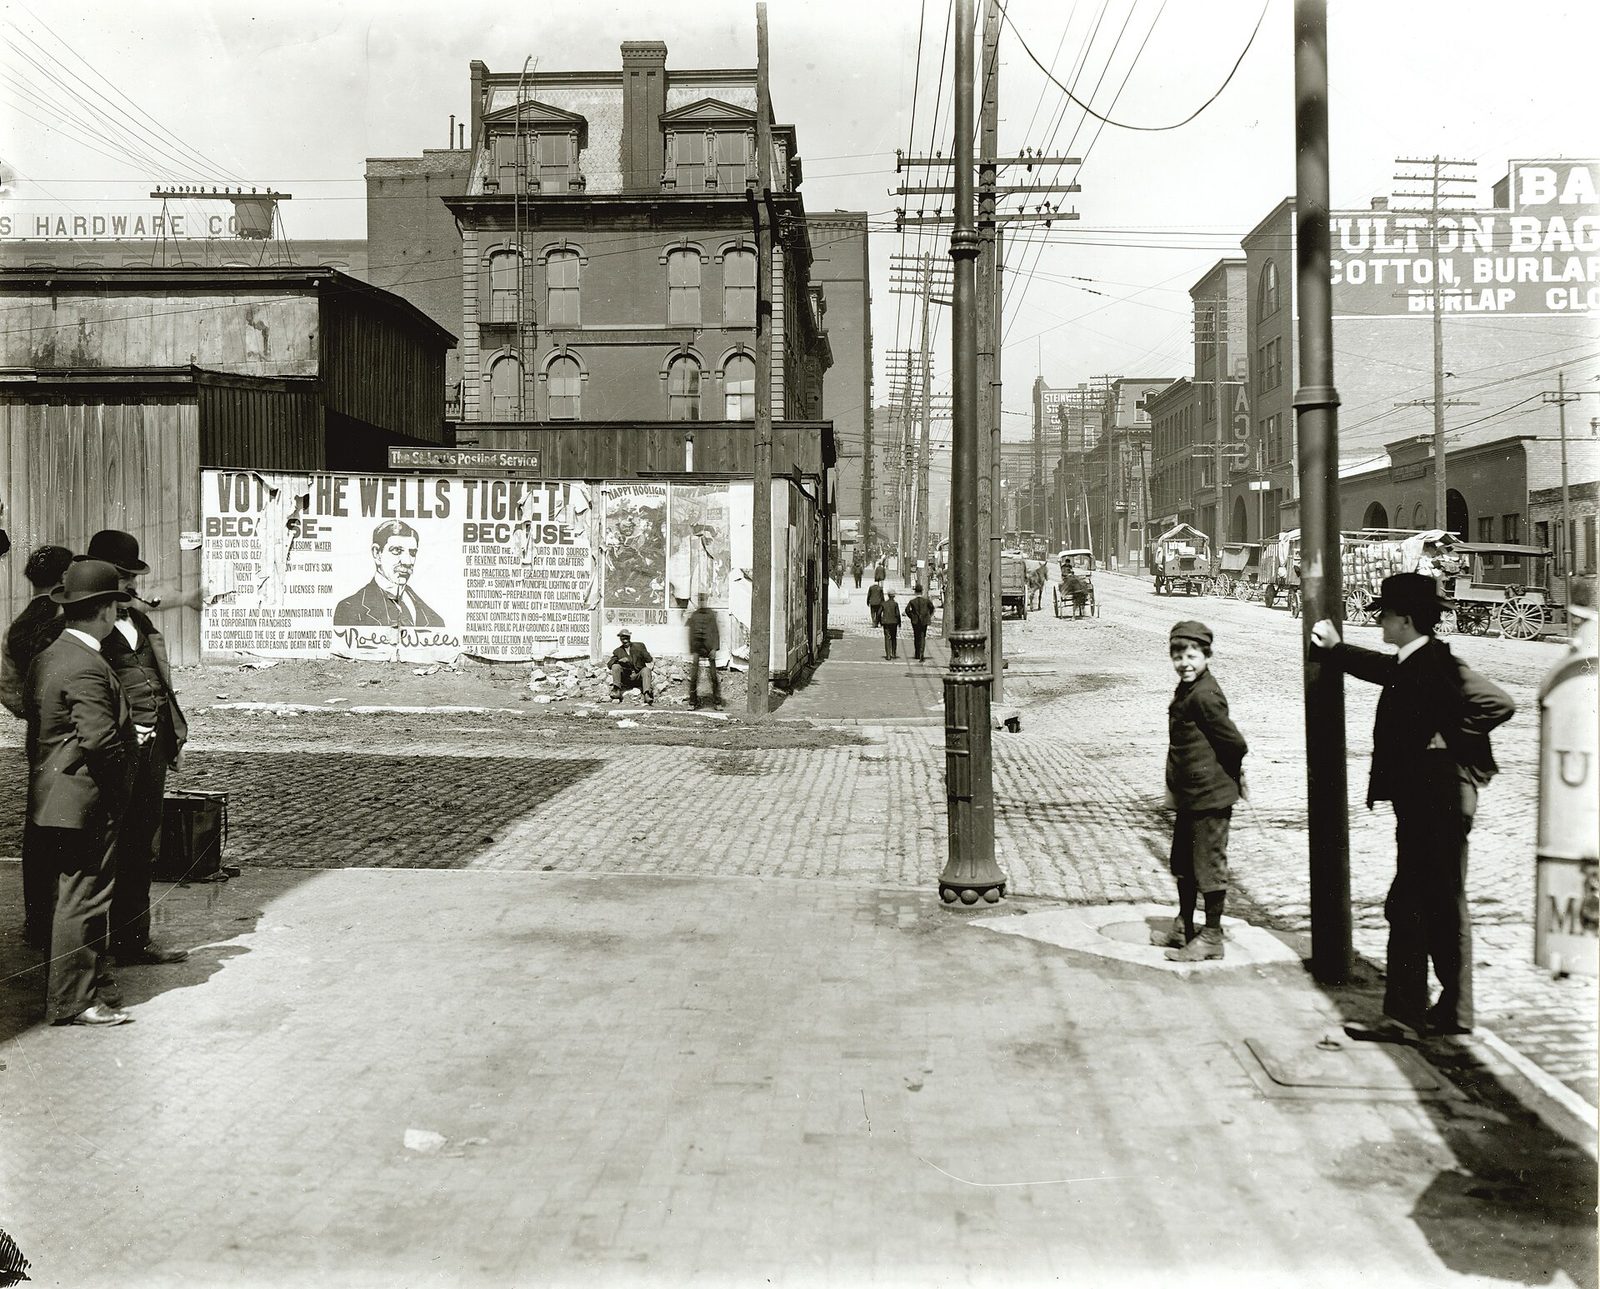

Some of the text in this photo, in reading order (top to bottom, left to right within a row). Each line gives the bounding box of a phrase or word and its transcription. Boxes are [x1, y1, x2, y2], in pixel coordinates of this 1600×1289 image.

[36, 215, 185, 235] HARDWARE
[1407, 288, 1516, 311] BURLAP
[391, 451, 410, 464] The
[457, 452, 497, 466] Posting
[499, 453, 538, 467] Service
[217, 473, 264, 513] VOT
[303, 475, 349, 517] HE
[359, 477, 450, 519] WELLS
[205, 539, 211, 548] IT
[212, 539, 223, 548] HAS
[224, 539, 240, 548] GIVEN
[241, 540, 249, 548] US
[250, 540, 261, 548] CLE
[314, 541, 332, 550] WATER
[212, 551, 223, 560] HAS
[224, 551, 240, 560] GIVEN
[241, 551, 249, 560] US
[462, 545, 589, 557] IT HAS TURNED THE URTS INTO SOURCES
[465, 555, 472, 564] OF
[474, 556, 497, 565] REVENUE
[498, 556, 521, 565] INSTEAD
[546, 558, 556, 566] FOR
[557, 558, 584, 567] GRAFTERS
[304, 563, 320, 572] CITY'S
[321, 563, 333, 572] SICK
[463, 568, 469, 577] IT
[469, 568, 480, 577] HAS
[511, 569, 522, 578] NOT
[289, 584, 315, 594] LICENSES
[317, 585, 333, 594] FROM
[494, 580, 515, 589] SHOWN
[522, 580, 548, 589] MUNICIPAL
[548, 581, 571, 590] LIGHTING
[571, 581, 578, 590] OF
[544, 591, 555, 600] FOR
[556, 591, 581, 600] LIGHTING
[466, 600, 501, 610] MUNICIPALITY
[503, 601, 510, 610] OF
[511, 601, 529, 610] WHOLE
[530, 601, 542, 610] CITY
[211, 608, 218, 617] IS
[219, 608, 230, 617] THE
[231, 608, 246, 617] FIRST
[249, 609, 260, 617] AND
[261, 609, 276, 618] ONLY
[278, 609, 324, 618] ADMINISTRATION
[466, 612, 488, 621] PRESENT
[489, 612, 520, 621] CONTRACTS
[520, 612, 527, 621] IN
[547, 613, 562, 622] MILES
[562, 613, 568, 621] OF
[567, 613, 590, 622] ELECTRIC
[658, 610, 668, 624] 26
[208, 618, 292, 627] TAX CORPORATION FRANCHISES
[494, 623, 511, 632] PUBLIC
[550, 624, 555, 633] &
[556, 624, 570, 633] BATH
[570, 624, 590, 633] HOUSES
[204, 630, 210, 639] IT
[211, 630, 222, 639] HAS
[223, 630, 253, 640] COMPELLED
[254, 631, 264, 640] THE
[265, 631, 276, 640] USE
[278, 631, 285, 640] OF
[287, 631, 317, 640] AUTOMATIC
[208, 640, 218, 649] ERS
[219, 640, 224, 649] &
[225, 640, 234, 649] AIR
[256, 640, 289, 650] DECREASING
[290, 641, 306, 650] DEATH
[307, 641, 321, 650] RATE
[462, 635, 490, 645] MUNICIPAL
[492, 635, 521, 645] COLLECTION
[559, 636, 566, 645] OF
[566, 636, 590, 646] GARBAGE
[480, 646, 500, 655] SAVING
[501, 646, 508, 655] OF
